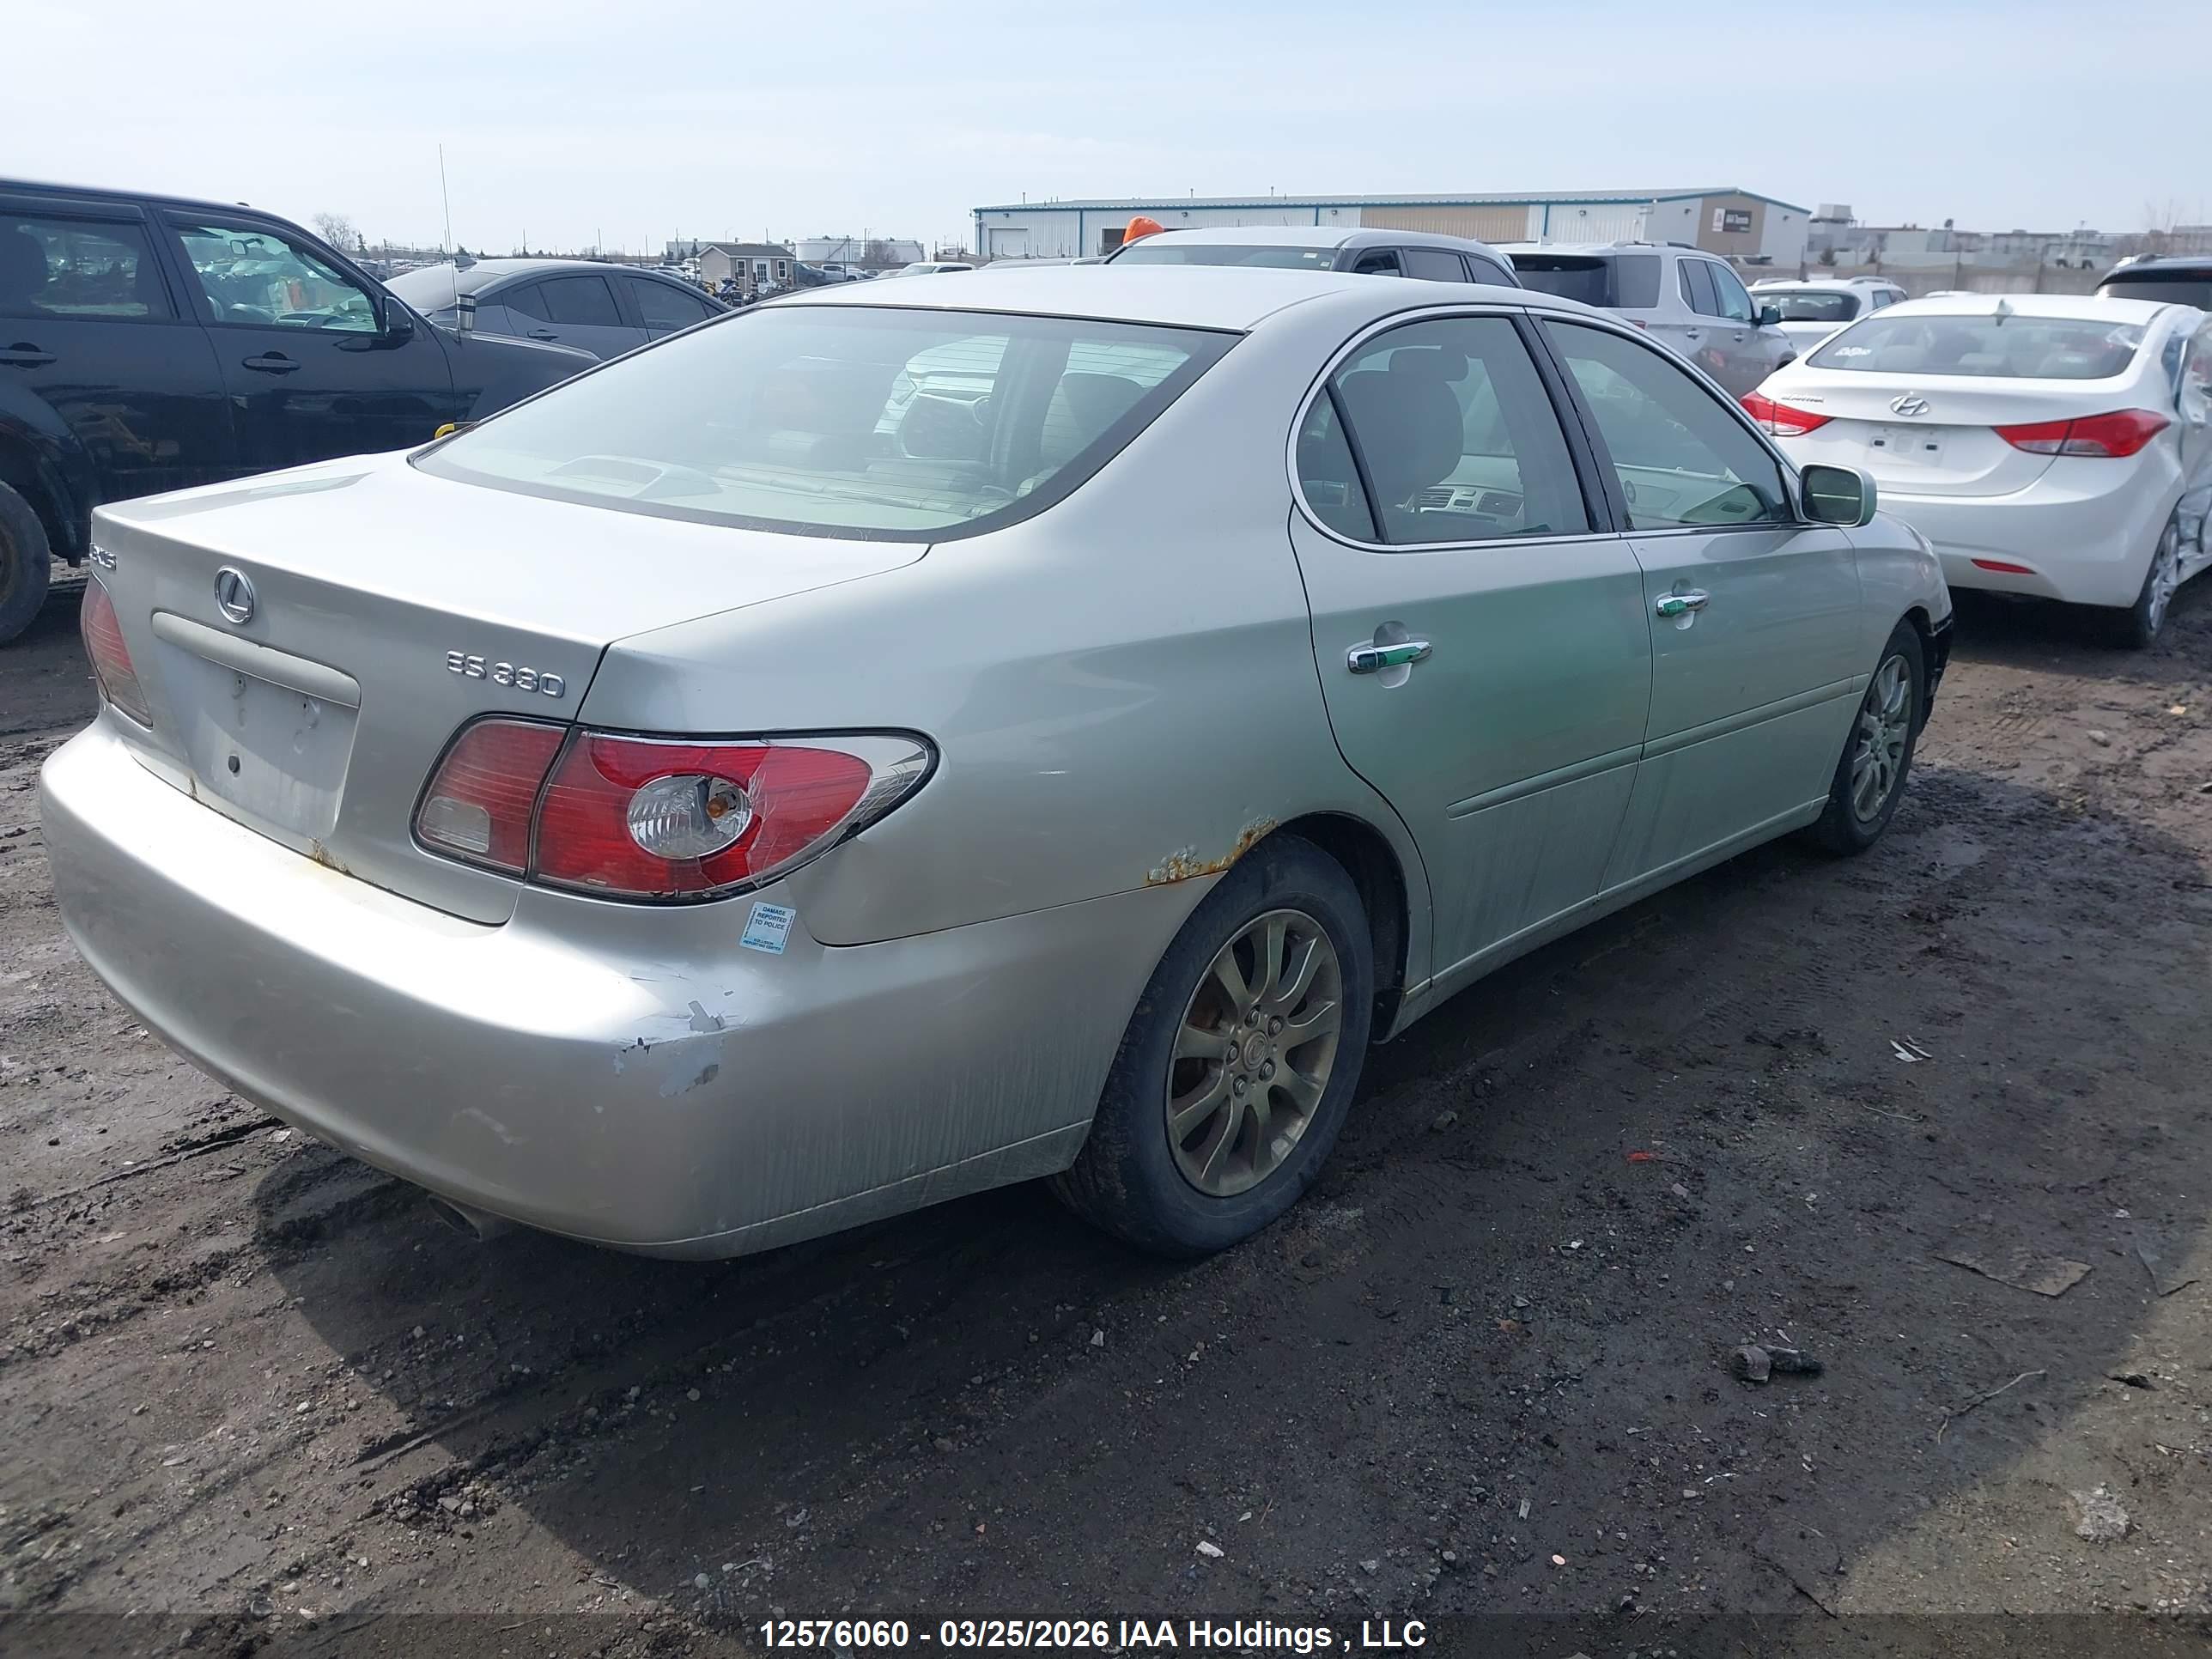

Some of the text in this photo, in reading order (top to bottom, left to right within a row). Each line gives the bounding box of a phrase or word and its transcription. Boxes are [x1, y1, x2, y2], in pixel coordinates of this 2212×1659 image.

[447, 650, 566, 698] ES 330
[763, 906, 787, 916] DAMAGE
[757, 912, 787, 923] REPORTED
[763, 921, 785, 930] POLICE
